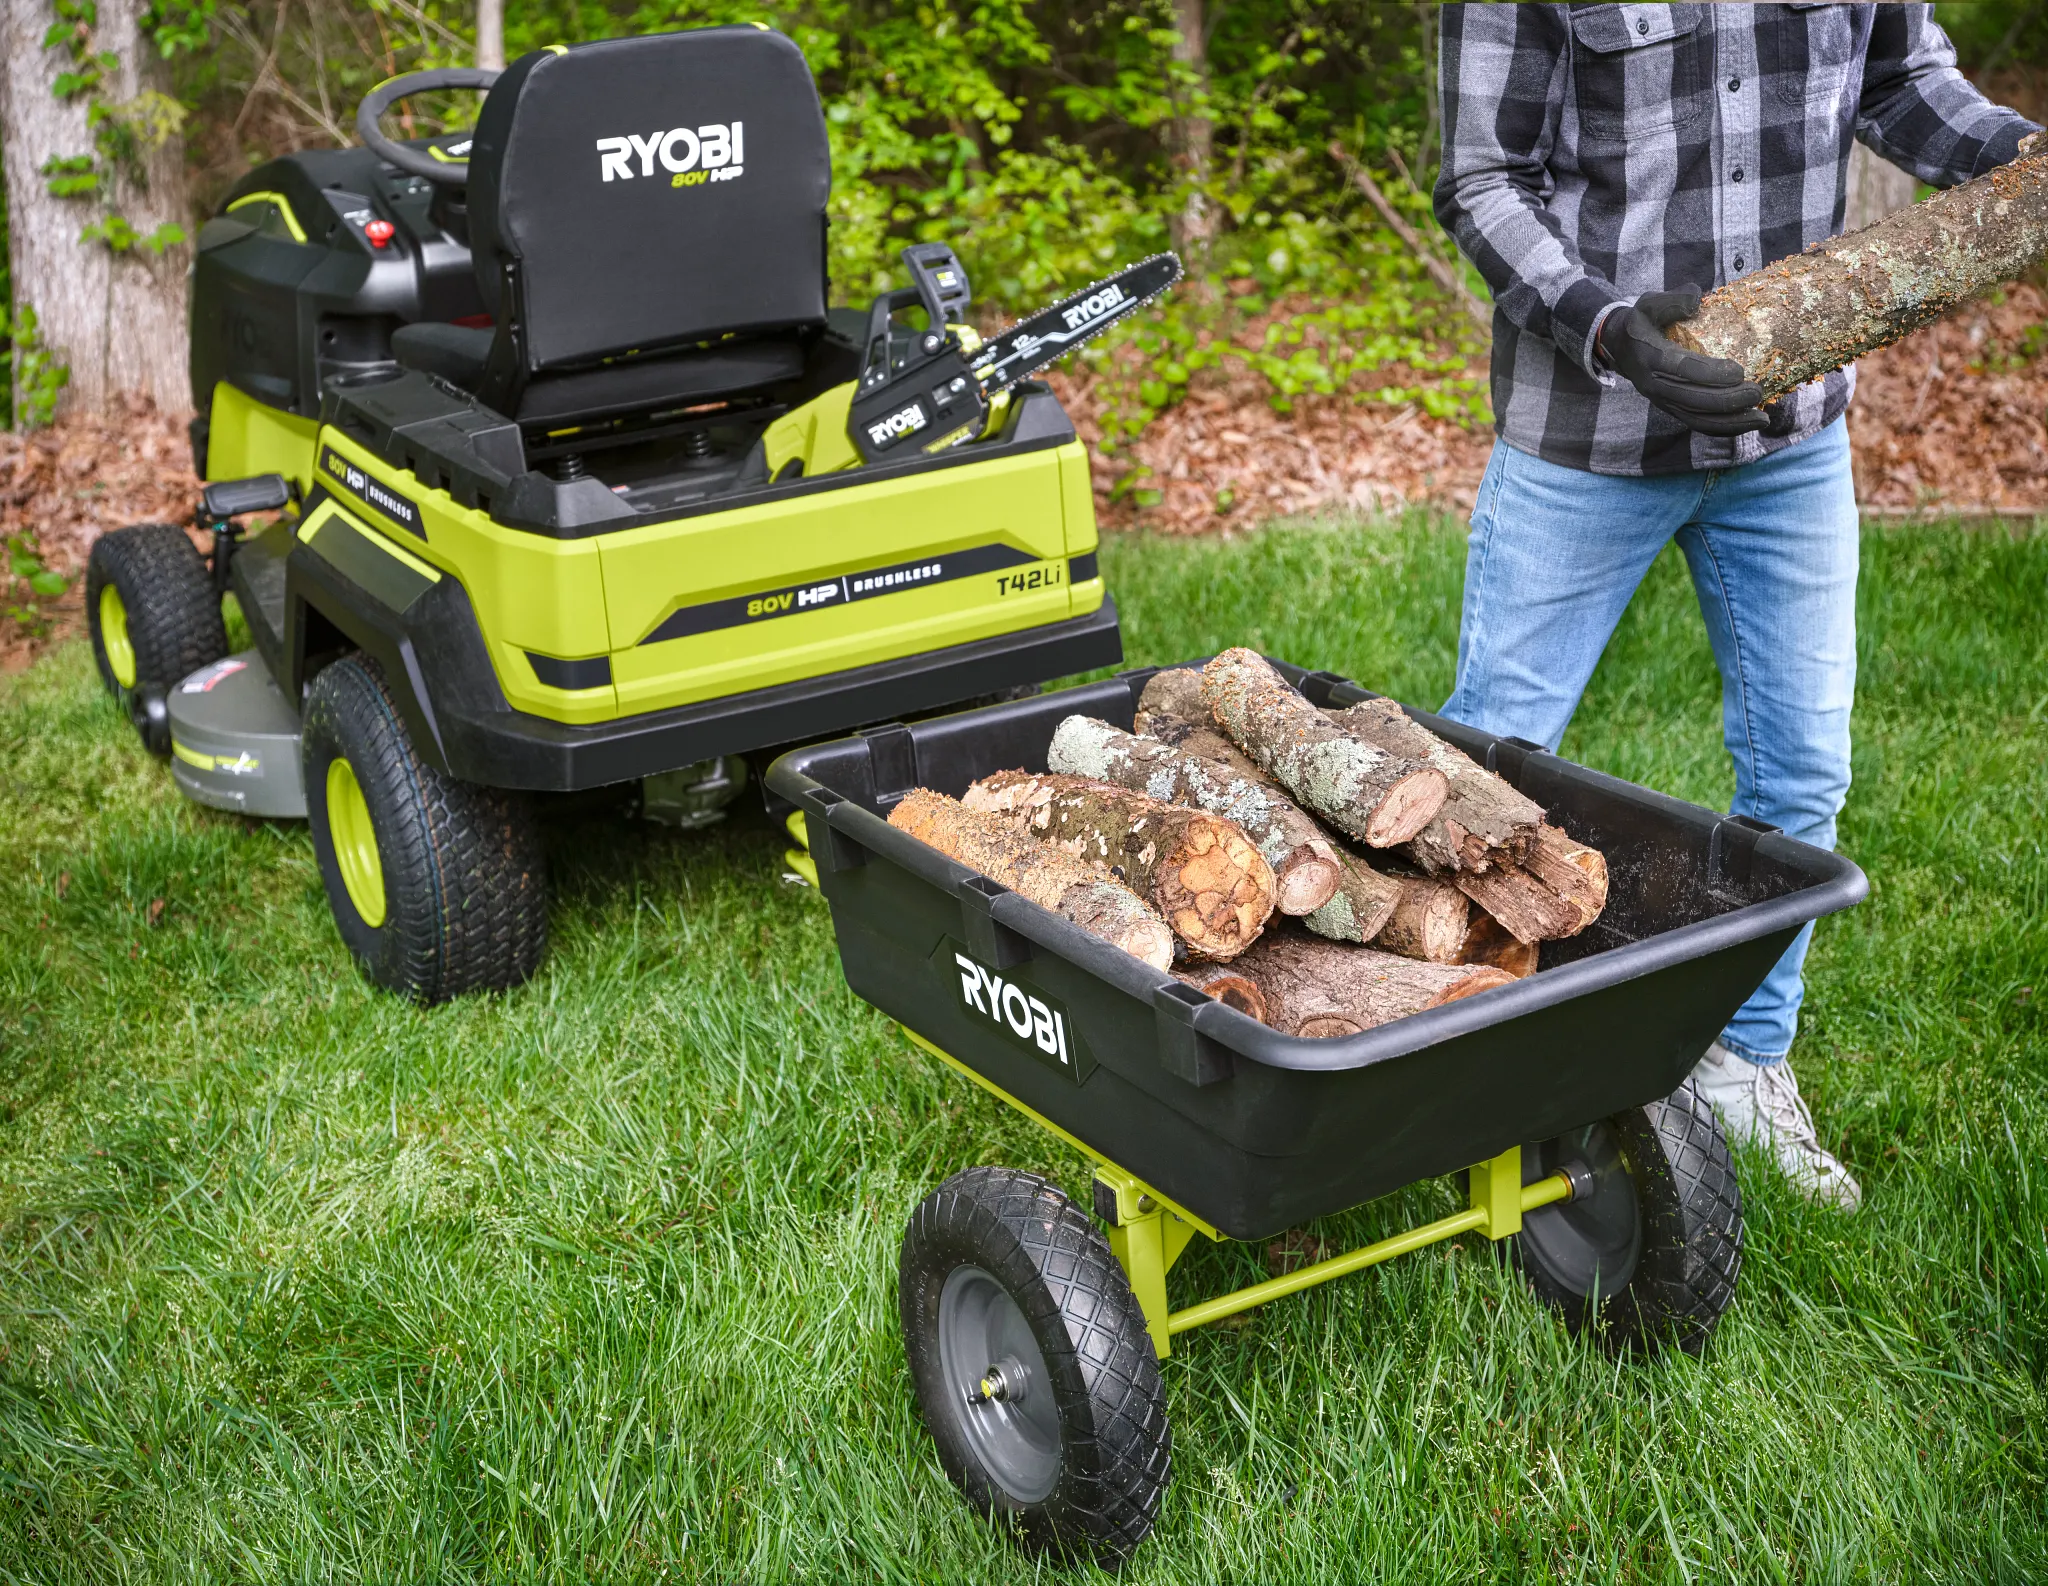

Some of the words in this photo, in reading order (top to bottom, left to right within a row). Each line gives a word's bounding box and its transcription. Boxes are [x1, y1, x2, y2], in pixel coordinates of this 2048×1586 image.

[597, 121, 744, 182] RYOBI
[671, 170, 710, 188] 80V
[710, 165, 744, 182] HP
[1061, 283, 1125, 330] RYOBI
[867, 403, 926, 445] RYOBI
[346, 467, 365, 490] HP
[369, 485, 413, 522] BRUSHLESS
[746, 592, 795, 617] 80V
[798, 583, 839, 607] HP
[853, 563, 942, 593] BRUSHLESS
[996, 564, 1061, 596] T42Li
[954, 952, 1069, 1066] RYOBI
